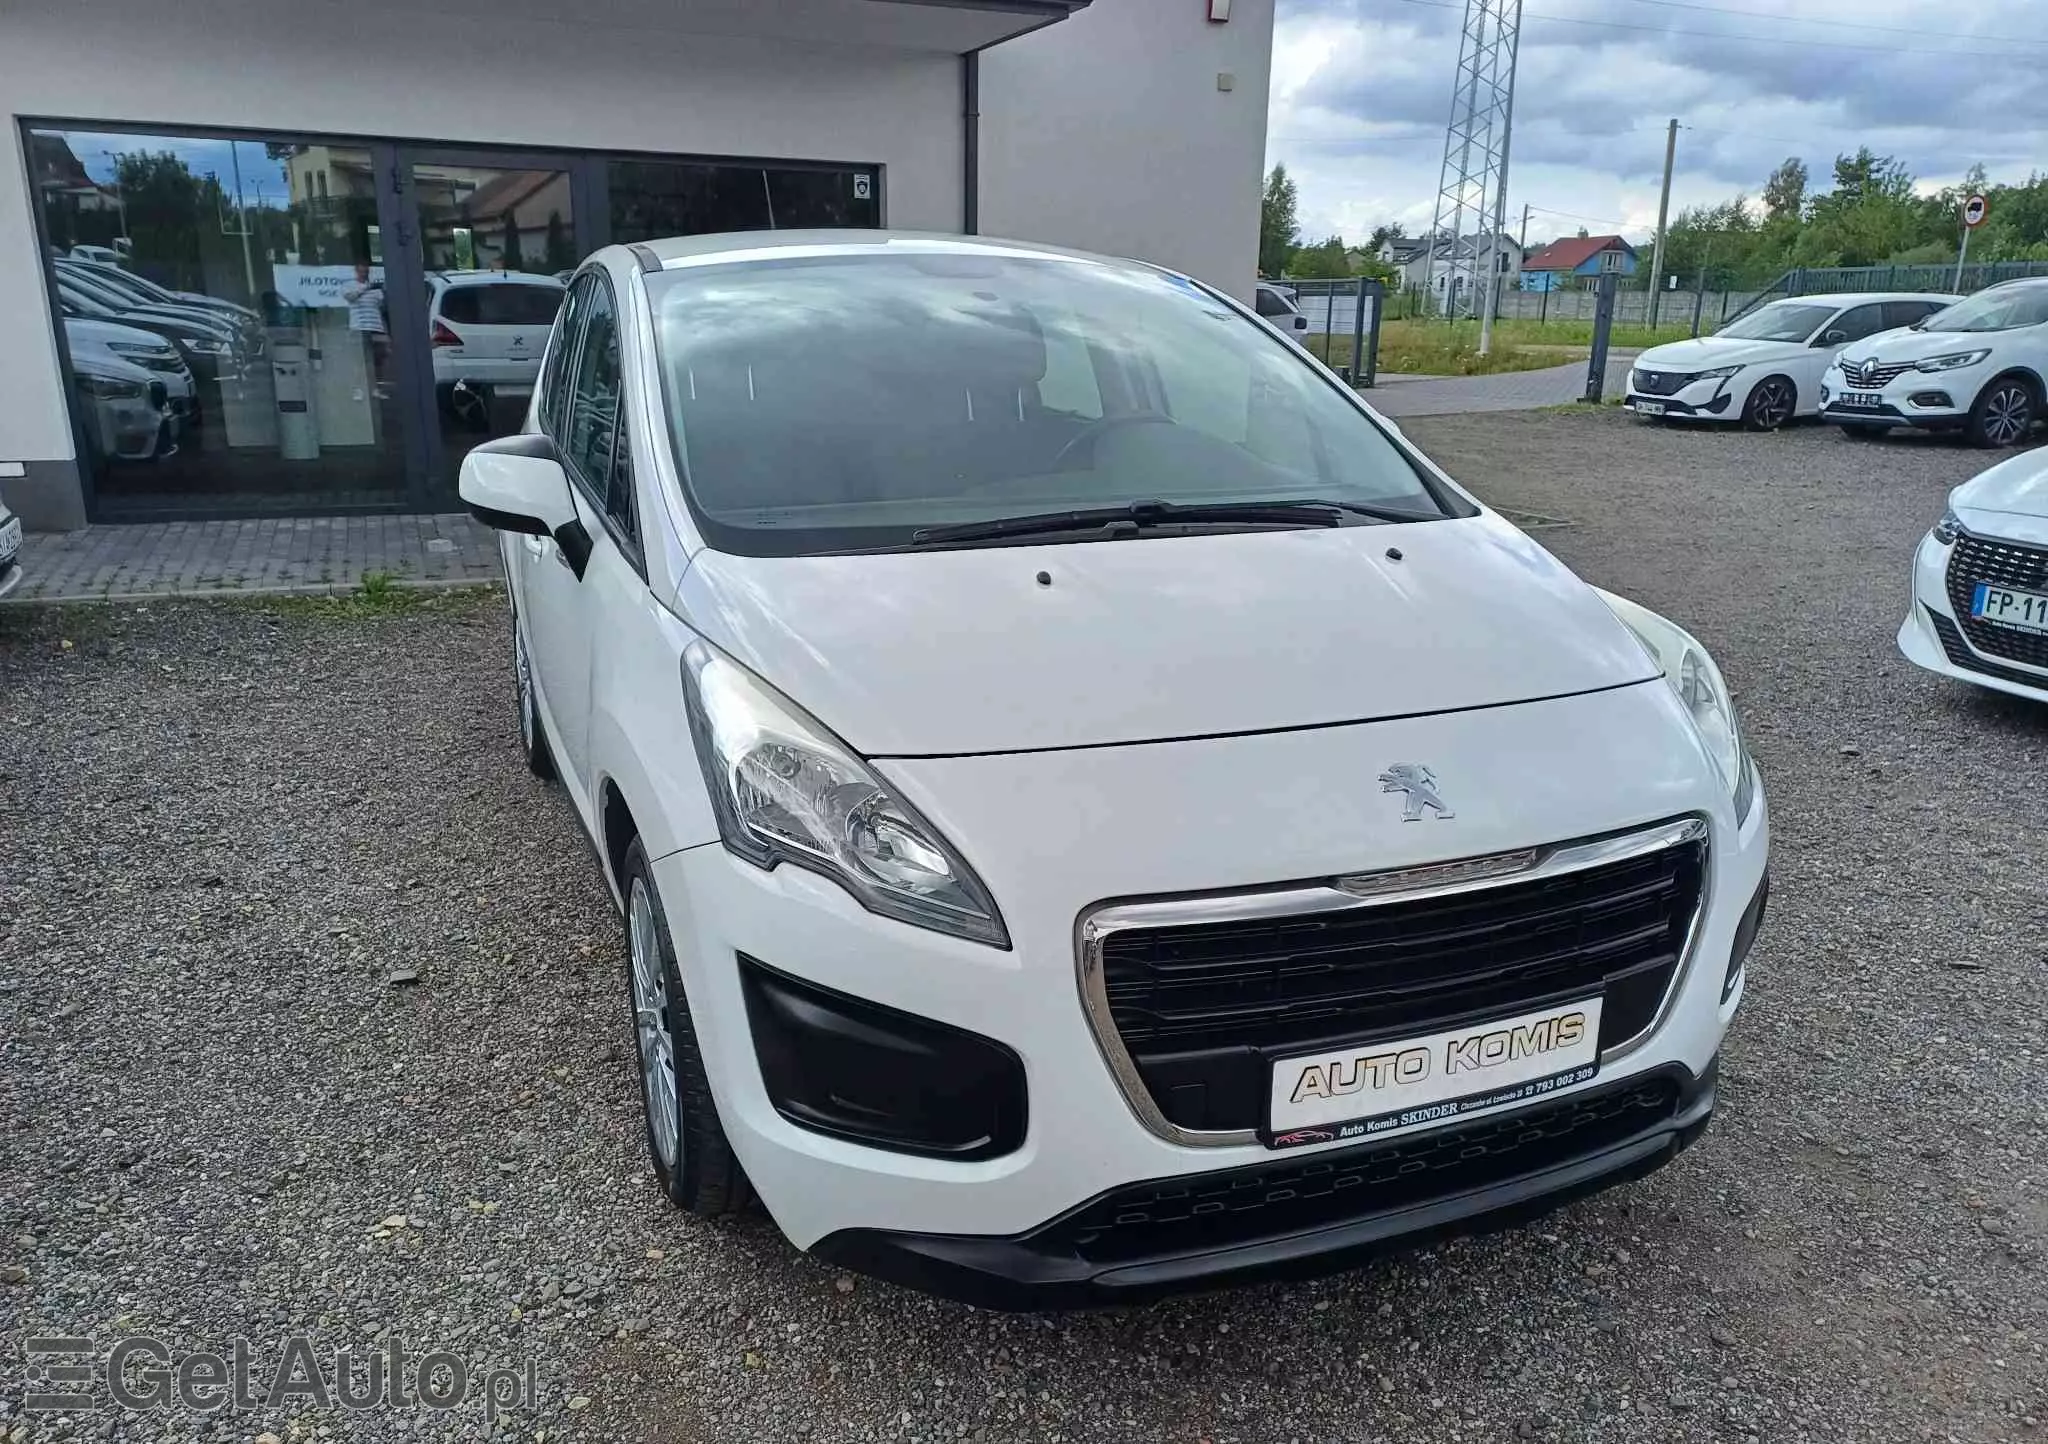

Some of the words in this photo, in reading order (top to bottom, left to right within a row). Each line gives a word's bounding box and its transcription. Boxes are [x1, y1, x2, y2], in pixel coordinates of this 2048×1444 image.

[1289, 1046, 1432, 1103] AUTO
[1446, 1012, 1586, 1075] KOMIS
[1340, 1125, 1365, 1137] Auto
[1367, 1117, 1399, 1132] Komis
[1400, 1102, 1459, 1126] SKINDER
[1536, 1079, 1554, 1094] 793
[1556, 1073, 1575, 1087] 002
[1576, 1066, 1594, 1081] 309
